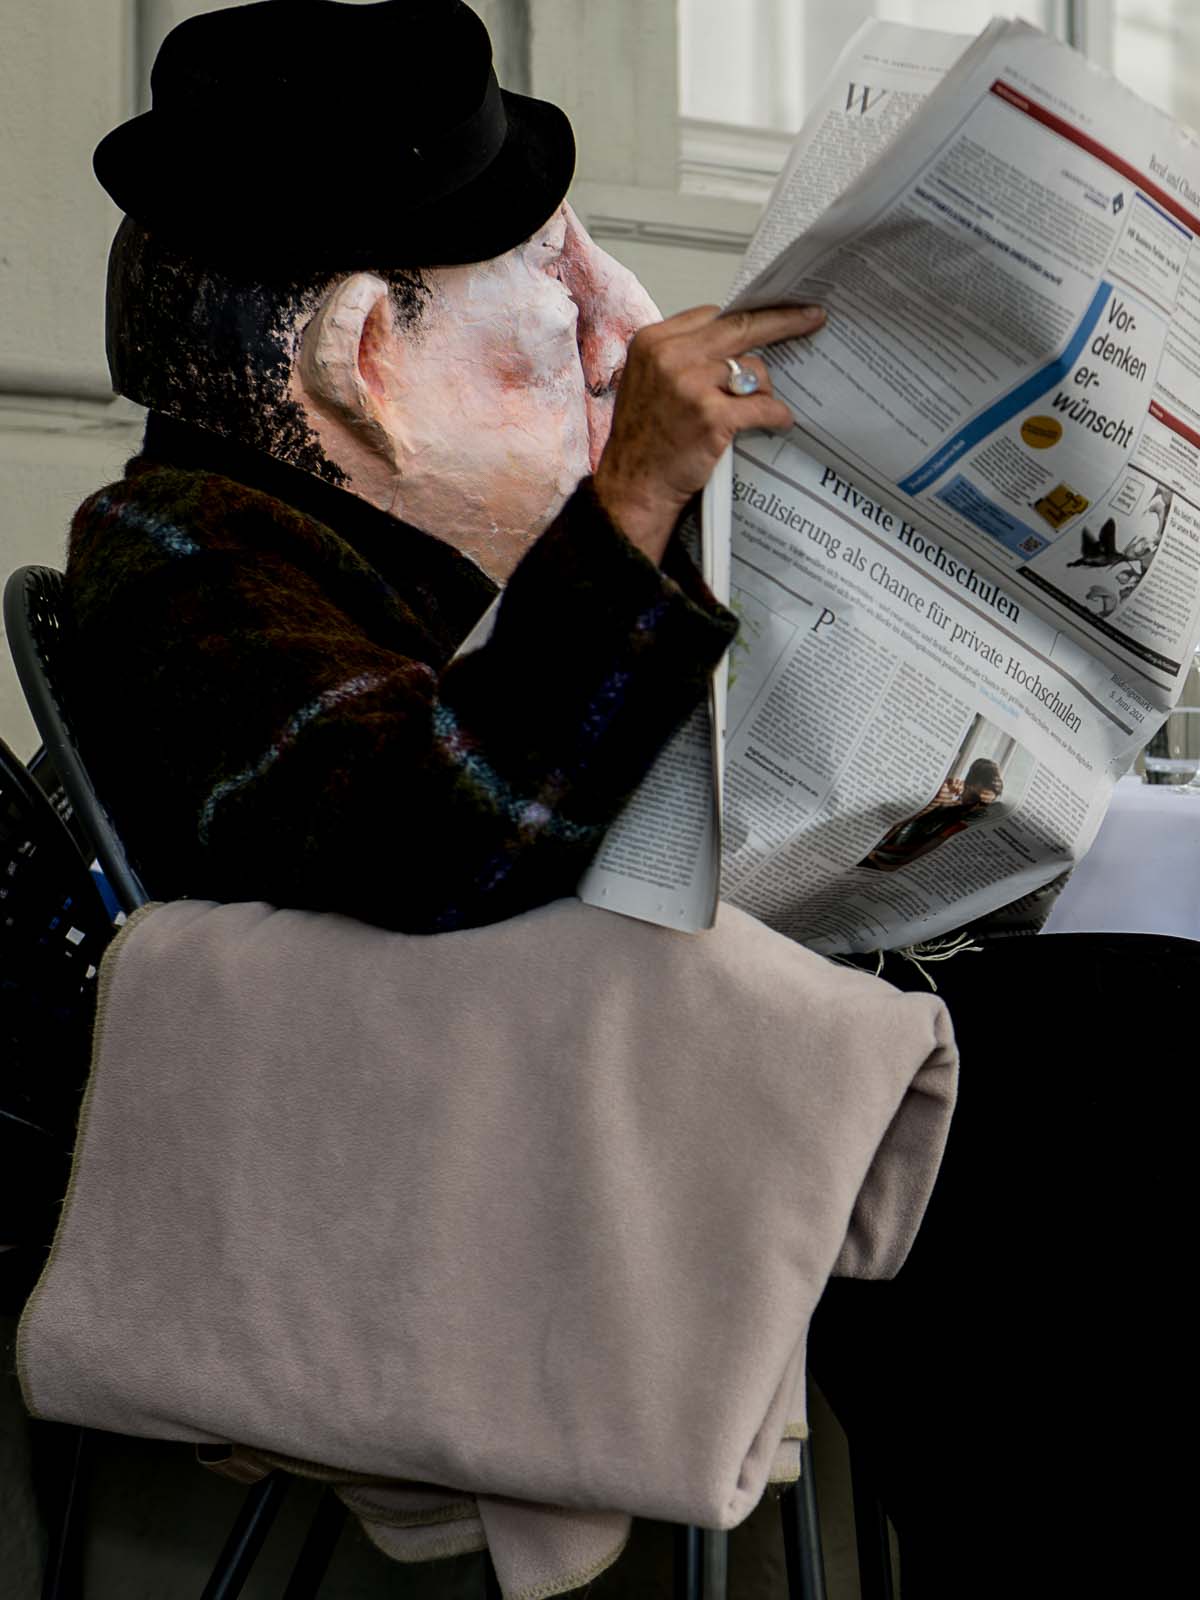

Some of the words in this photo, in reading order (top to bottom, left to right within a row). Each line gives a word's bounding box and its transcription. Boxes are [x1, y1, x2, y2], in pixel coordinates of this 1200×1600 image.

[845, 82, 887, 115] W
[1108, 298, 1136, 333] Vor-
[1074, 366, 1100, 389] er-
[1091, 333, 1147, 382] denken
[1052, 391, 1134, 449] wünscht
[820, 467, 893, 532] Private
[897, 521, 1020, 624] Hochschulen
[732, 473, 841, 560] igitalisierung
[842, 546, 868, 572] als
[869, 561, 925, 613] Chance
[926, 601, 952, 630] für
[949, 623, 1003, 669] private
[1004, 657, 1082, 734] Hochschulen
[810, 607, 836, 633] P
